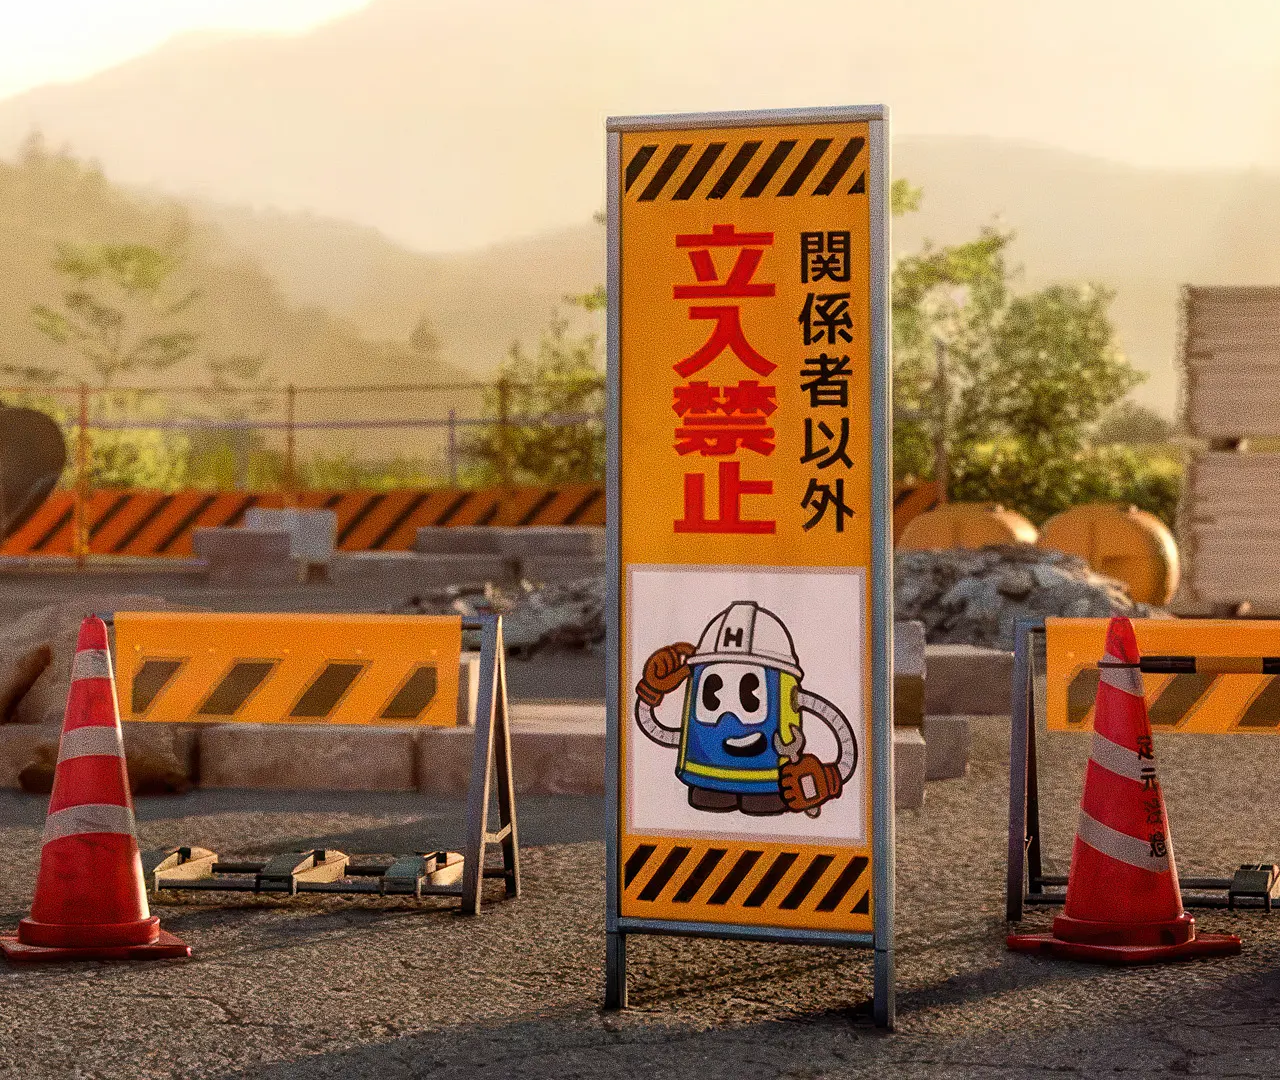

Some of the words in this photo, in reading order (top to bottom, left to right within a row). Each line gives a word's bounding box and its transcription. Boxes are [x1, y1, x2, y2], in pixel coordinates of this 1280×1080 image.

[672, 223, 778, 535] 立入禁止
[797, 230, 856, 533] 関係者以外
